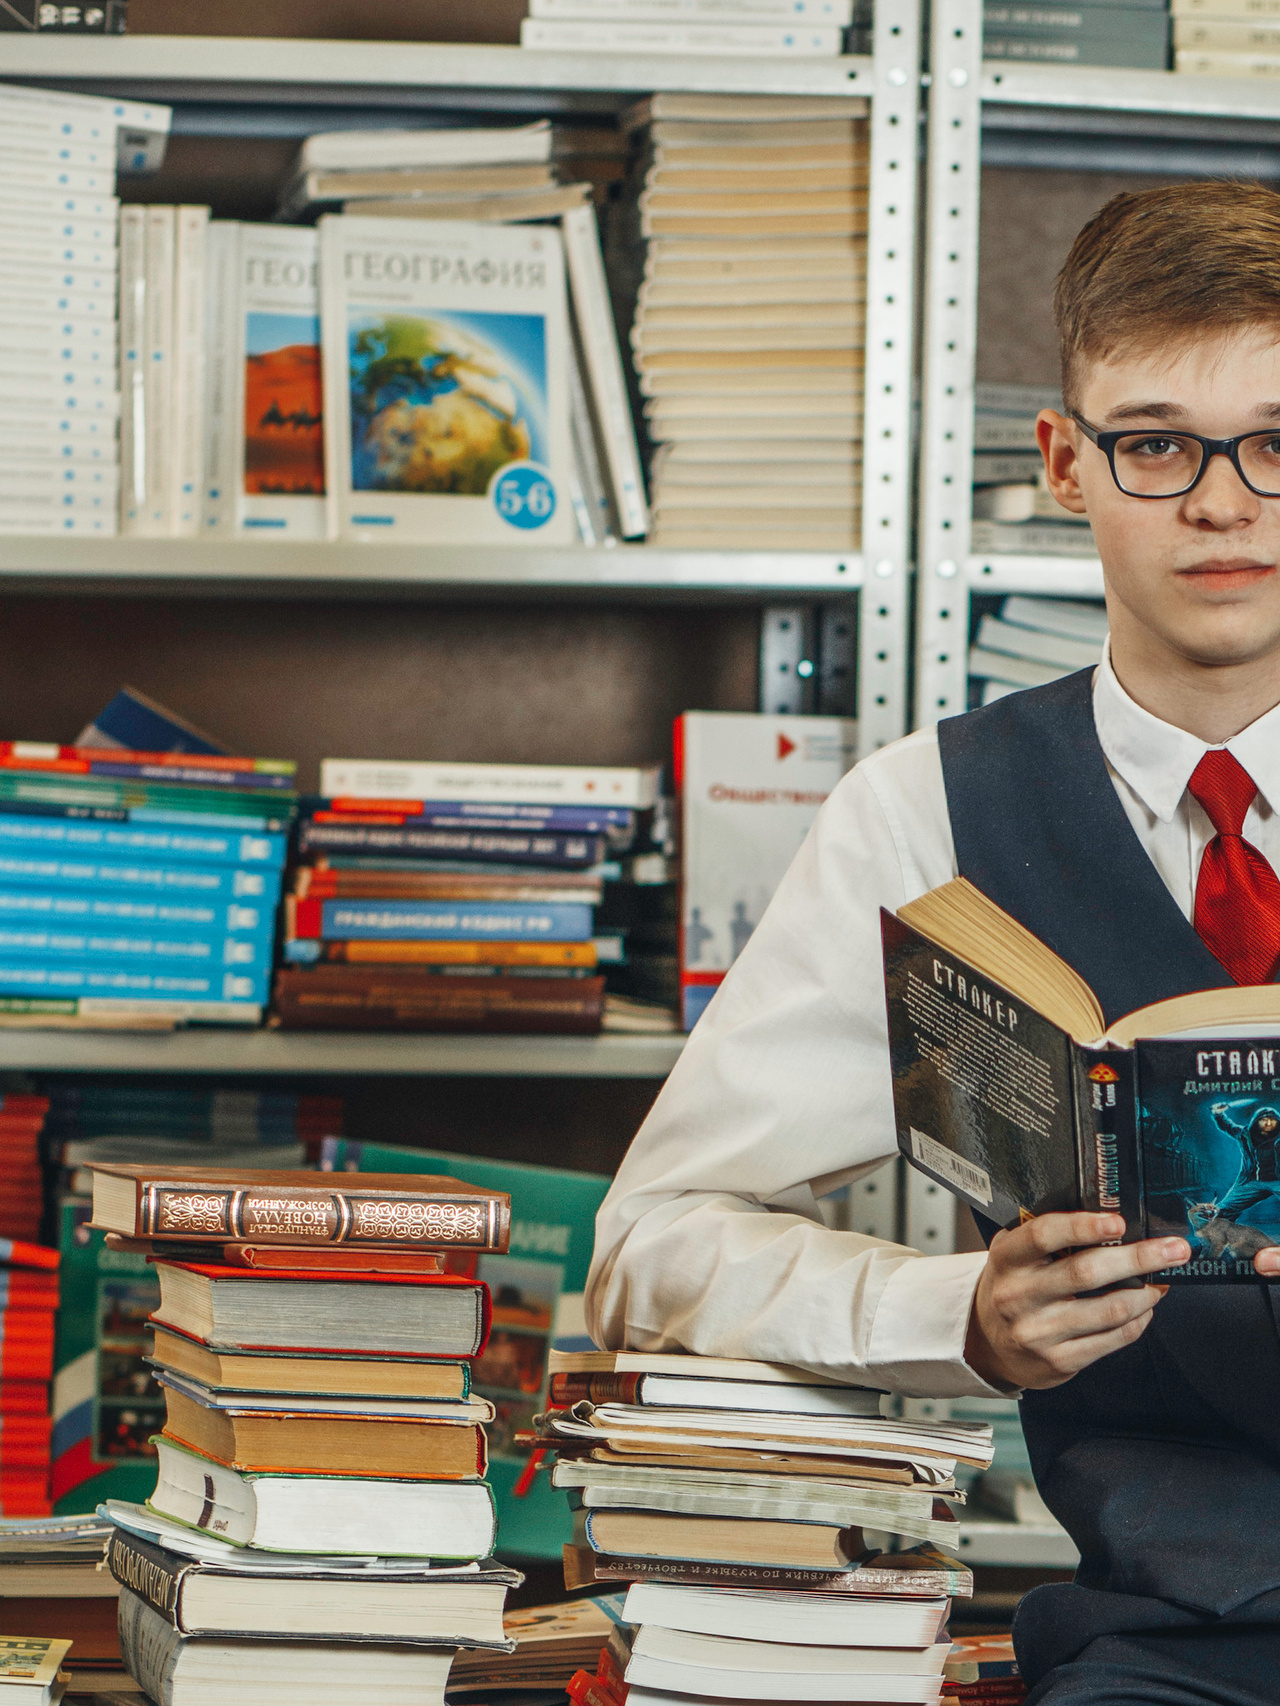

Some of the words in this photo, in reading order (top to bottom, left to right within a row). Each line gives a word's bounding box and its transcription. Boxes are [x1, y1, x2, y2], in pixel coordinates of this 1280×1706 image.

[343, 251, 546, 288] ГЕОГРАФИЯ
[932, 957, 1019, 1032] СТАЛКЕР
[1183, 1079, 1264, 1096] Дмитрий
[247, 1198, 333, 1212] ВОЗРОЖДЕНИЯ
[251, 1210, 327, 1225] НОВЕЛЛА
[248, 1224, 330, 1237] ФРАНЦУЗСКАЯ
[608, 1561, 686, 1573] ТВОРЧЕСТВУ
[704, 1566, 758, 1577] МУЗЫКЕ
[762, 1569, 780, 1578] ПО
[113, 1538, 174, 1611] МЕТАМОРФОЗЫ
[784, 1571, 841, 1582] УЧЕБНИК
[845, 1573, 897, 1587] ПЕРВЫЙ
[903, 1575, 929, 1585] МОЙ
